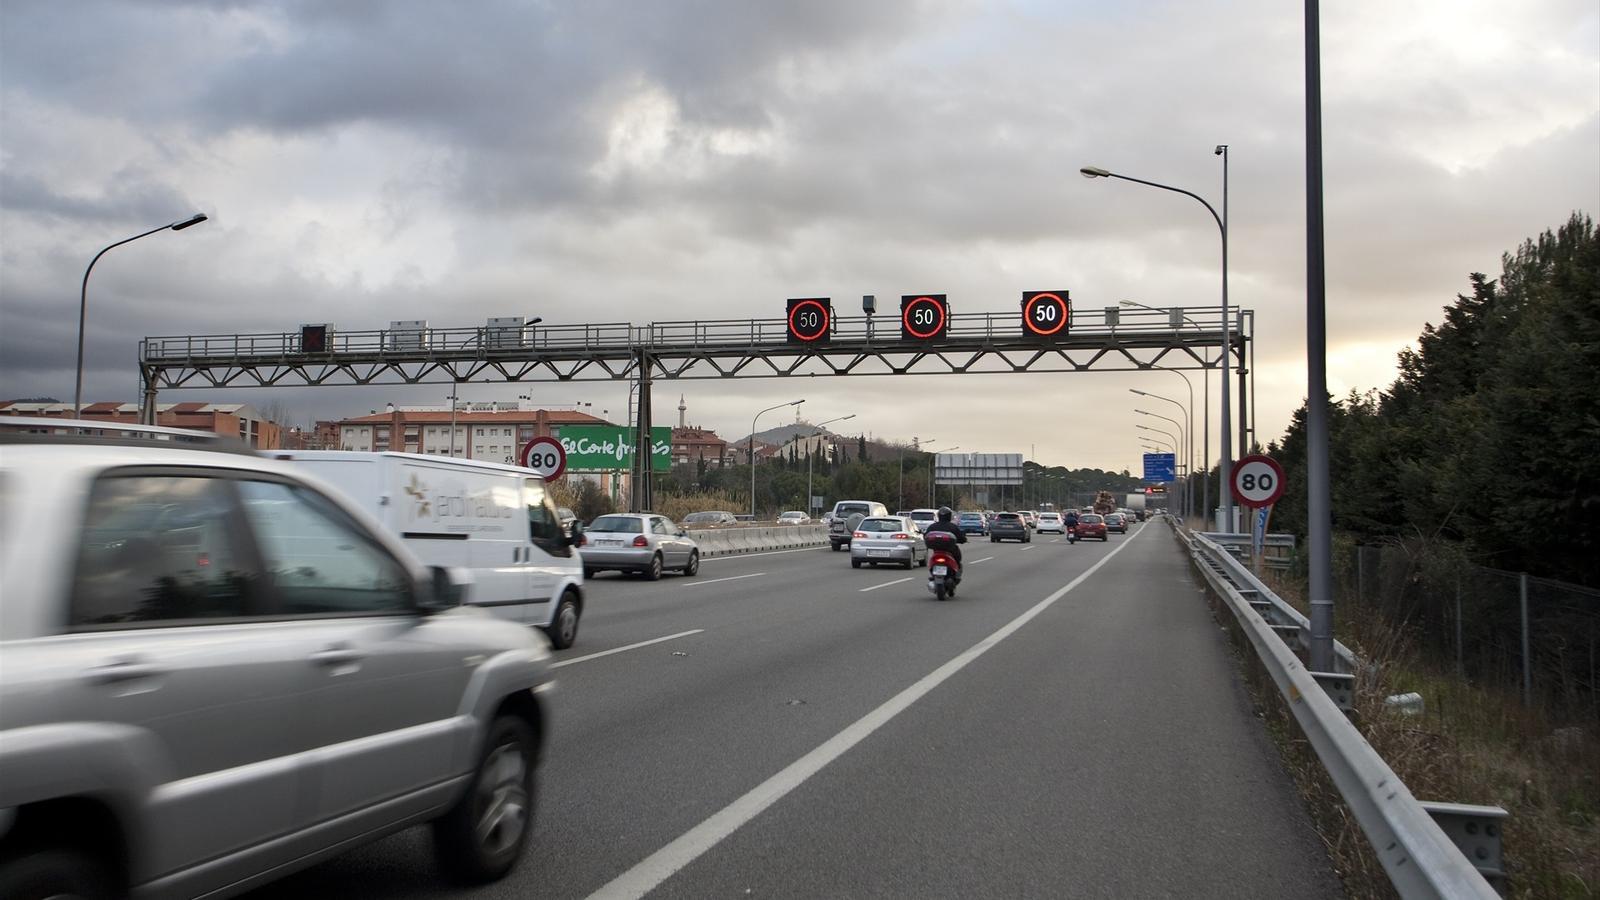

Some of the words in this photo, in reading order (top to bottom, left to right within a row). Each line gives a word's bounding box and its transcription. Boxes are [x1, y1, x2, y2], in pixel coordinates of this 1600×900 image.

[800, 312, 817, 327] 50
[915, 309, 933, 325] 50
[1036, 305, 1056, 321] 50
[560, 437, 577, 454] El
[577, 438, 614, 455] Corte
[531, 453, 556, 468] 80
[1242, 473, 1273, 491] 80
